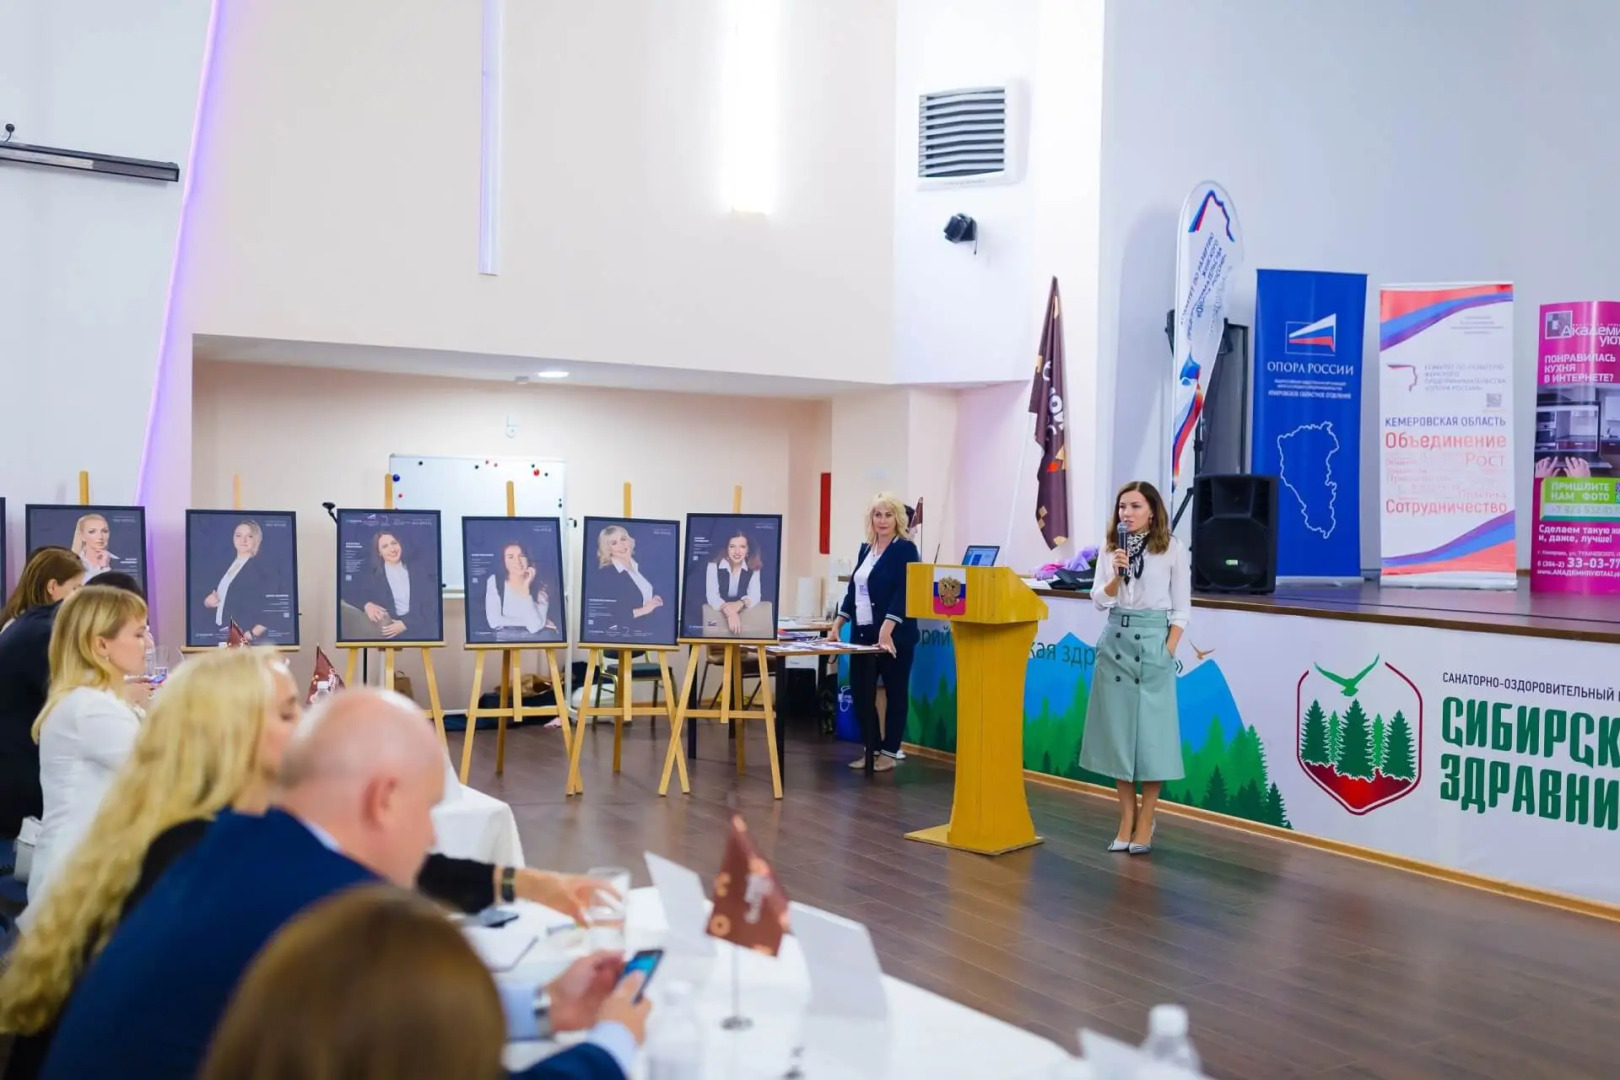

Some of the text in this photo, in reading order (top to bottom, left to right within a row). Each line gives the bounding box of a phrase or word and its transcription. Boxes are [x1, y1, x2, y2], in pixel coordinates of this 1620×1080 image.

[1544, 354, 1616, 363] ПОНРАВИЛАСЬ
[1267, 361, 1354, 376] ОПОРА РОССИИ
[1544, 364, 1576, 374] КУХНЯ
[1544, 373, 1614, 384] В ИНТЕРНЕТЕ?
[1385, 416, 1506, 427] КЕМЕРОВСКАЯ ОБЛАСТЬ
[1385, 431, 1507, 450] Объединение
[1466, 452, 1506, 467] Рост
[1551, 482, 1610, 492] ПРИШЛИТЕ
[1551, 492, 1610, 501] НАМ ФОТО
[1386, 499, 1508, 516] Сотрудничество
[1538, 524, 1580, 534] Сделаем
[1582, 527, 1610, 537] такую
[1548, 536, 1578, 544] даже,
[1580, 535, 1612, 544] лучше!
[1567, 557, 1620, 568] 33-03-77
[1442, 672, 1614, 701] САНАТОРНО-ОЗДОРОВИТЕЛЬНЫЙ
[1442, 696, 1620, 768] СИБИРСК
[1440, 754, 1620, 830] ЗДРАВНИ
